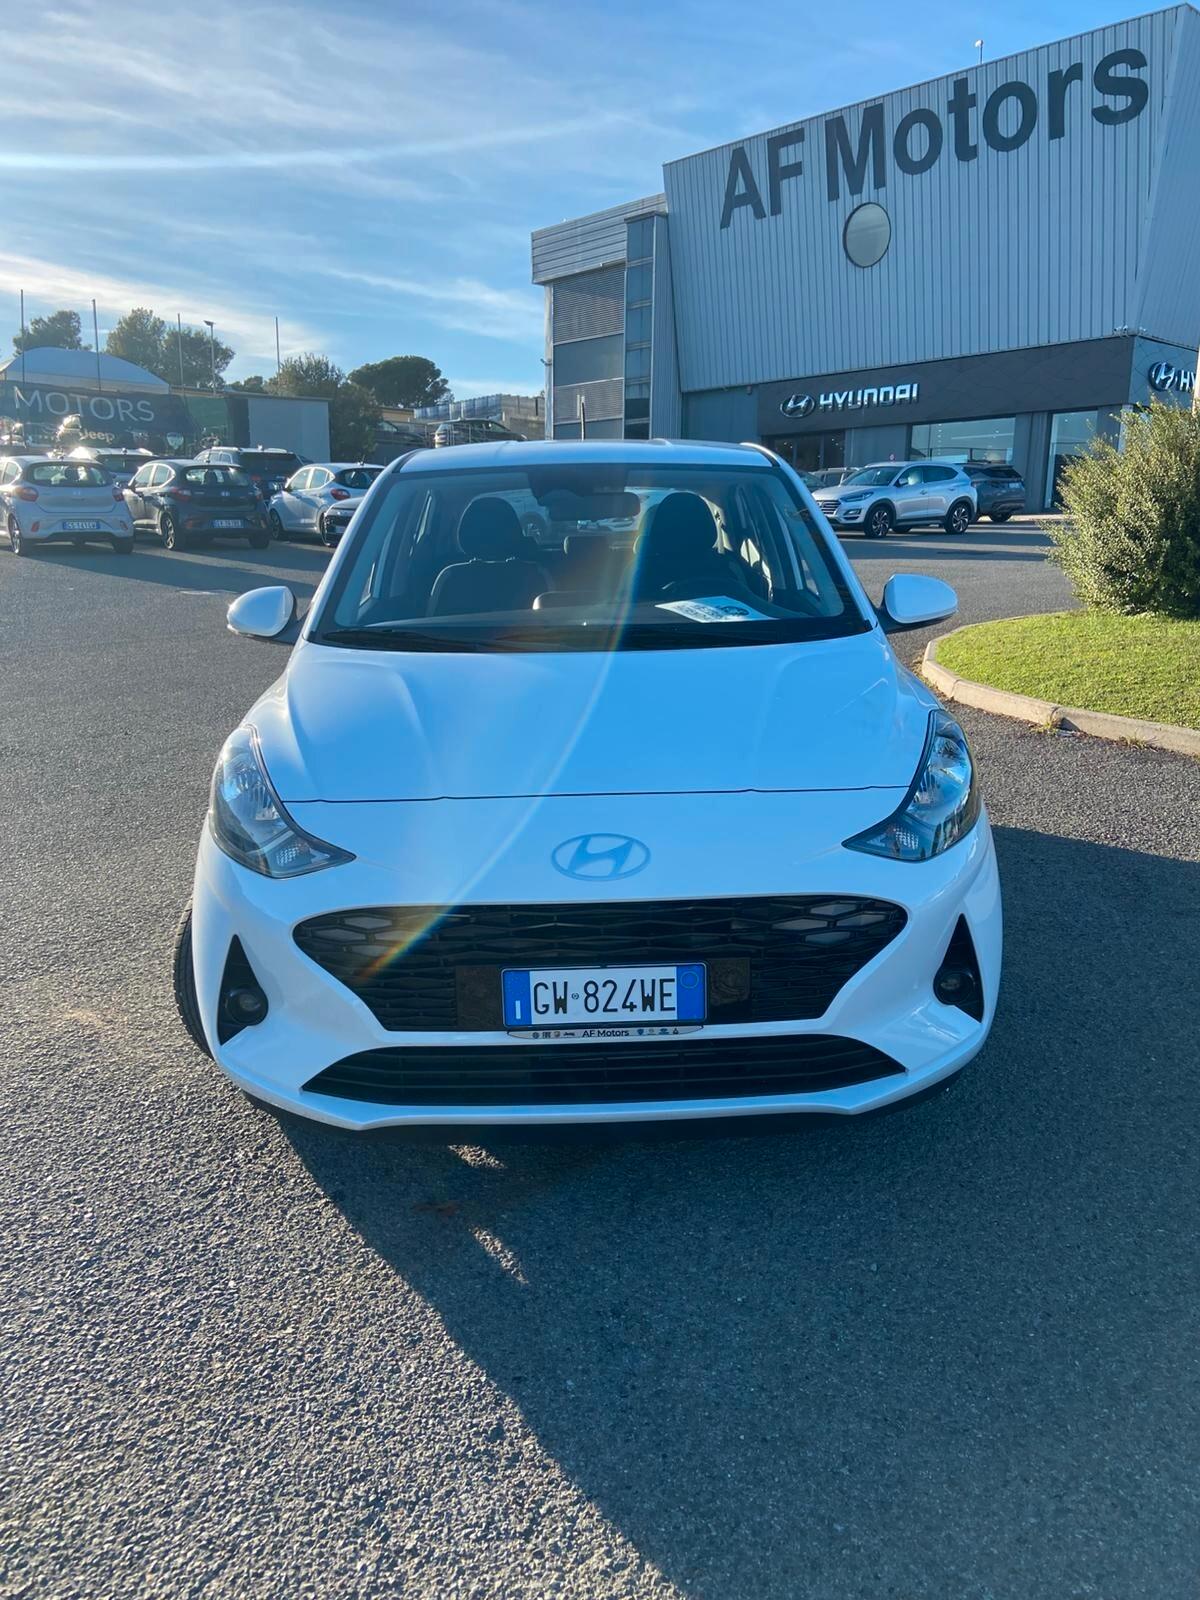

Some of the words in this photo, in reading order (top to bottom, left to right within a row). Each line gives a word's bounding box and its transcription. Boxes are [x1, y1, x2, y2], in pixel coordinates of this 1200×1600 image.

[719, 127, 805, 230] AF
[824, 48, 1149, 202] Motors
[13, 385, 155, 422] MOTORS
[819, 383, 918, 409] HYUNDAI
[582, 1029, 595, 1038] AF
[597, 1028, 630, 1038] Motors
